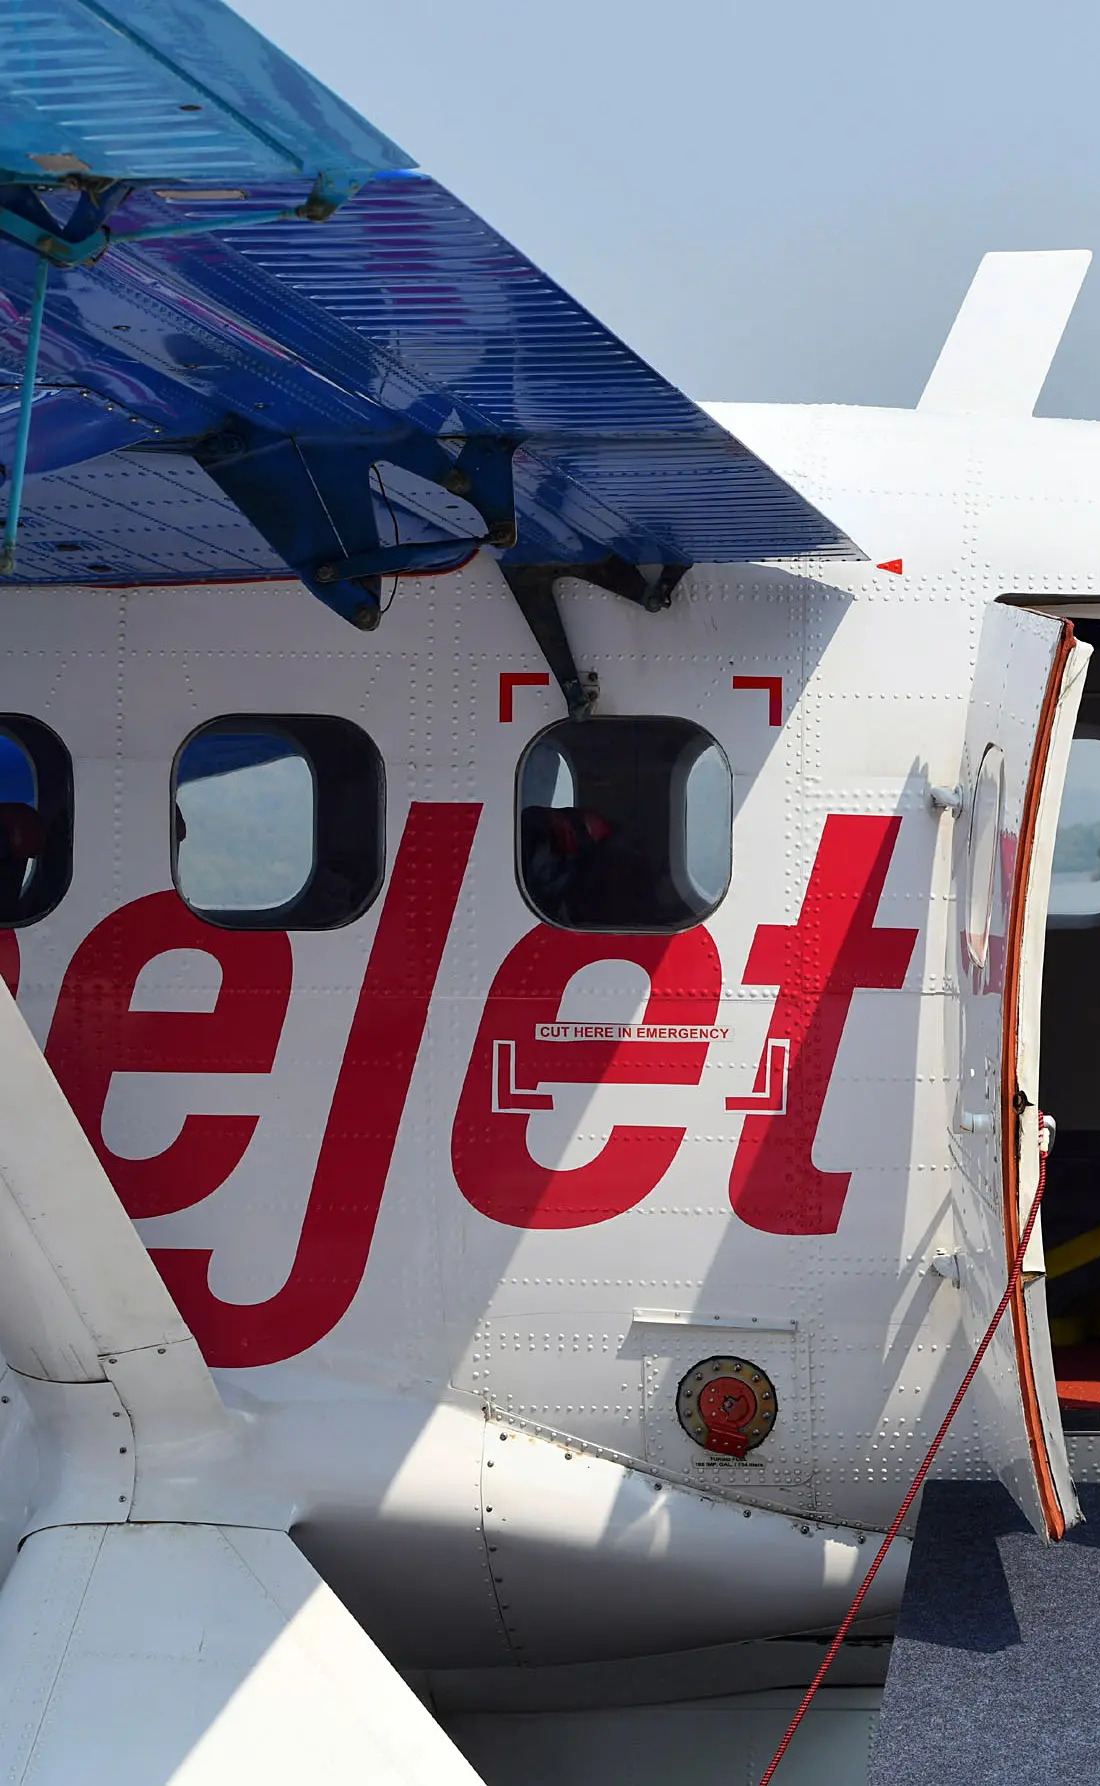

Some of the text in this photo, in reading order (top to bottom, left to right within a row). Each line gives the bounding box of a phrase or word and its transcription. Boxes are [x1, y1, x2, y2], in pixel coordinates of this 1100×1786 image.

[0, 803, 918, 1368] eJet
[540, 1026, 729, 1039] CUT HERE IN EMERGENCY
